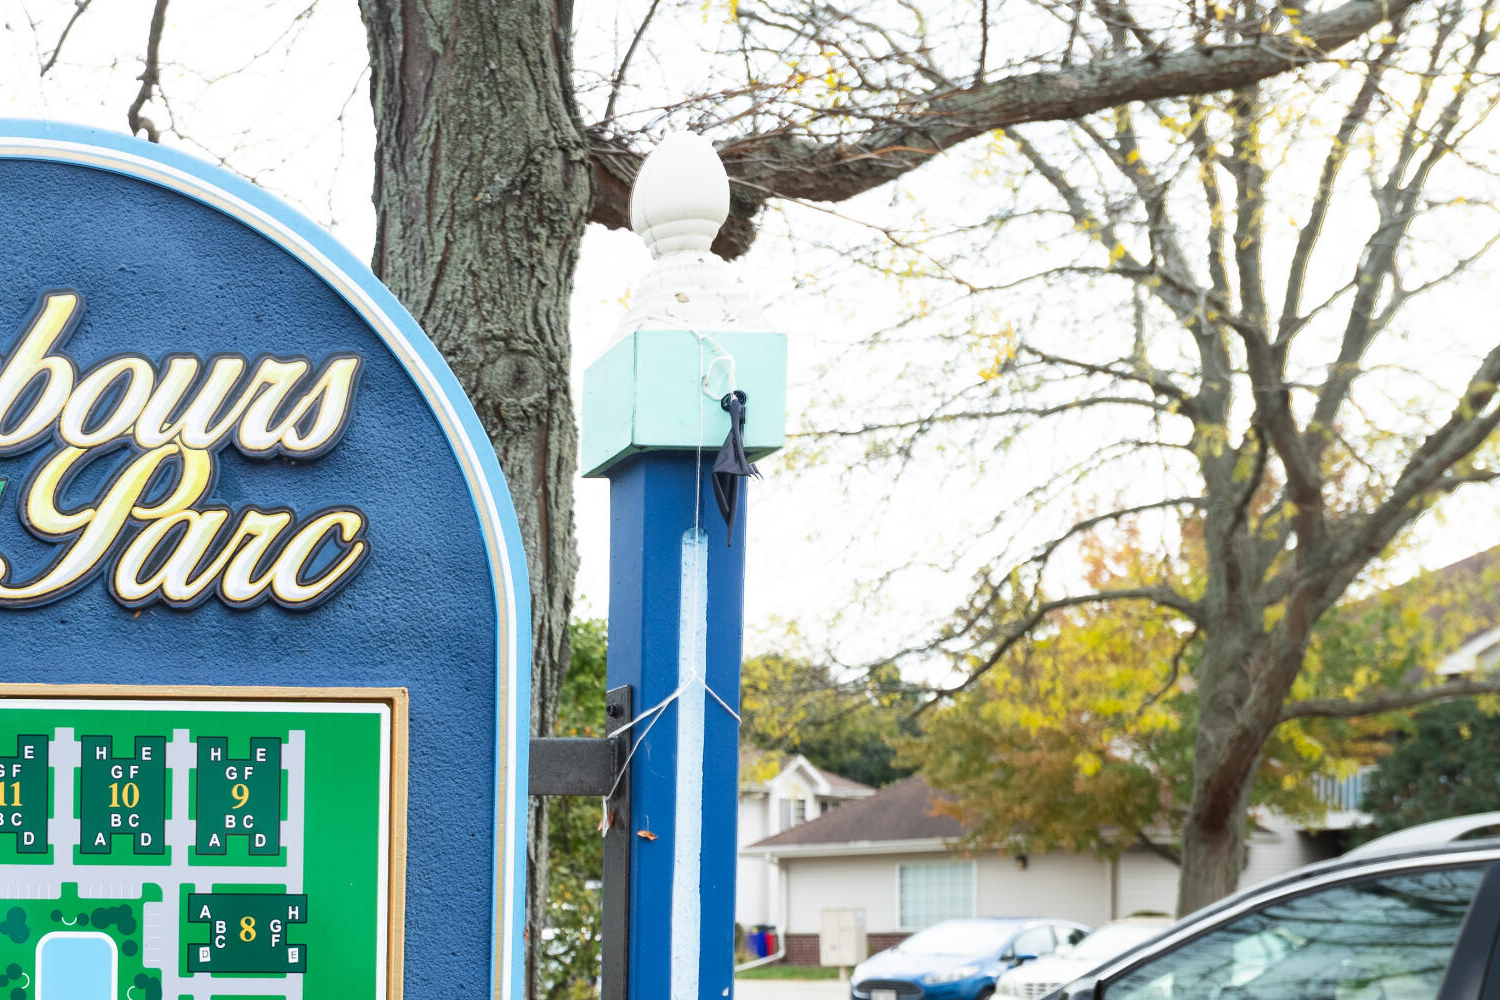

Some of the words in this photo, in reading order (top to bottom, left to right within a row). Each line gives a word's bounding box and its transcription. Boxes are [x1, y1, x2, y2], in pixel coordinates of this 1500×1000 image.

[24, 745, 35, 759] E
[96, 746, 107, 760] H
[141, 746, 152, 761] E
[210, 747, 222, 762] H
[256, 747, 267, 762] E
[225, 766, 238, 781] G
[244, 766, 254, 780] F
[109, 782, 140, 809] 10
[231, 783, 250, 809] 9
[225, 814, 236, 829] B
[242, 814, 254, 829] C
[23, 831, 35, 846] D
[94, 832, 107, 846] A
[140, 832, 152, 847] D
[208, 833, 221, 847] A
[255, 833, 267, 848] D
[199, 904, 212, 919] A
[288, 905, 299, 920] H
[215, 920, 227, 934] B
[239, 916, 257, 942] 8
[269, 919, 282, 933] G
[214, 934, 226, 949] C
[271, 933, 281, 948] F
